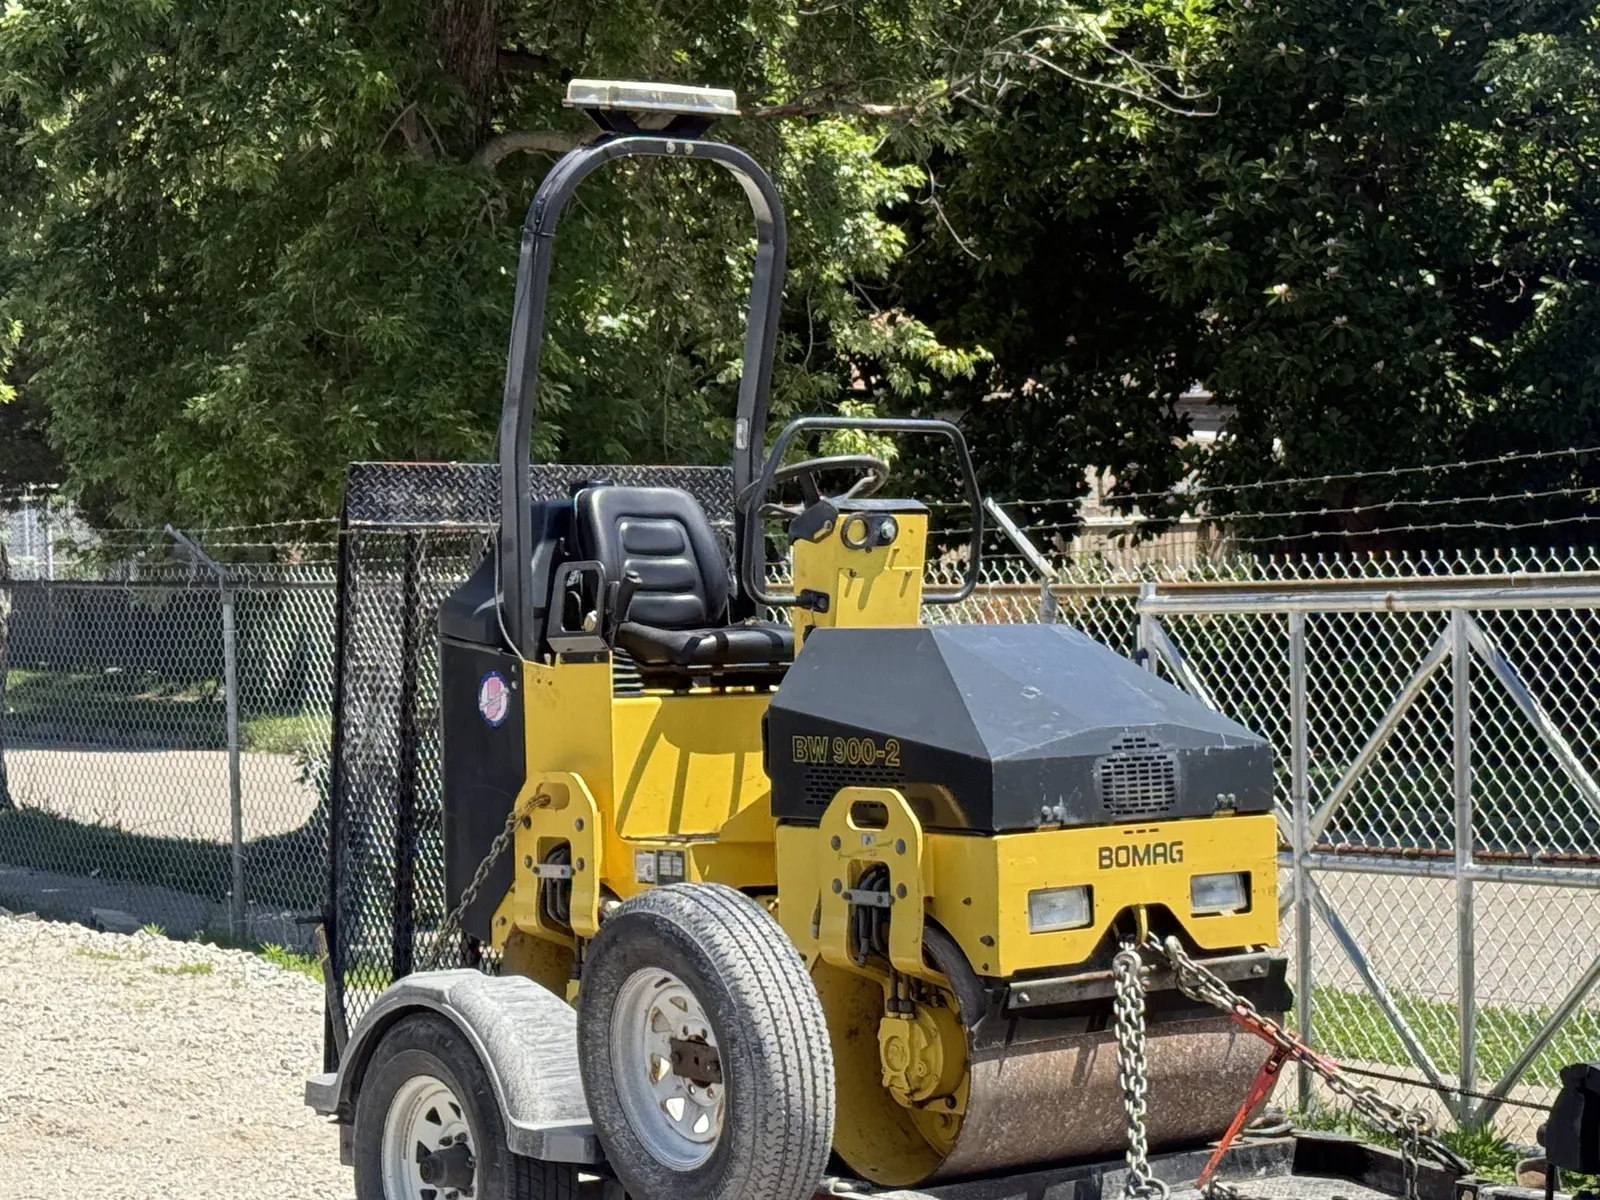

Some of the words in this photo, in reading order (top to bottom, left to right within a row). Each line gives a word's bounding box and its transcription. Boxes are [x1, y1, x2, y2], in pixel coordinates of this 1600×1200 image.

[792, 735, 829, 763] BW
[832, 737, 900, 766] 900-2
[1098, 841, 1184, 870] BOMAG
